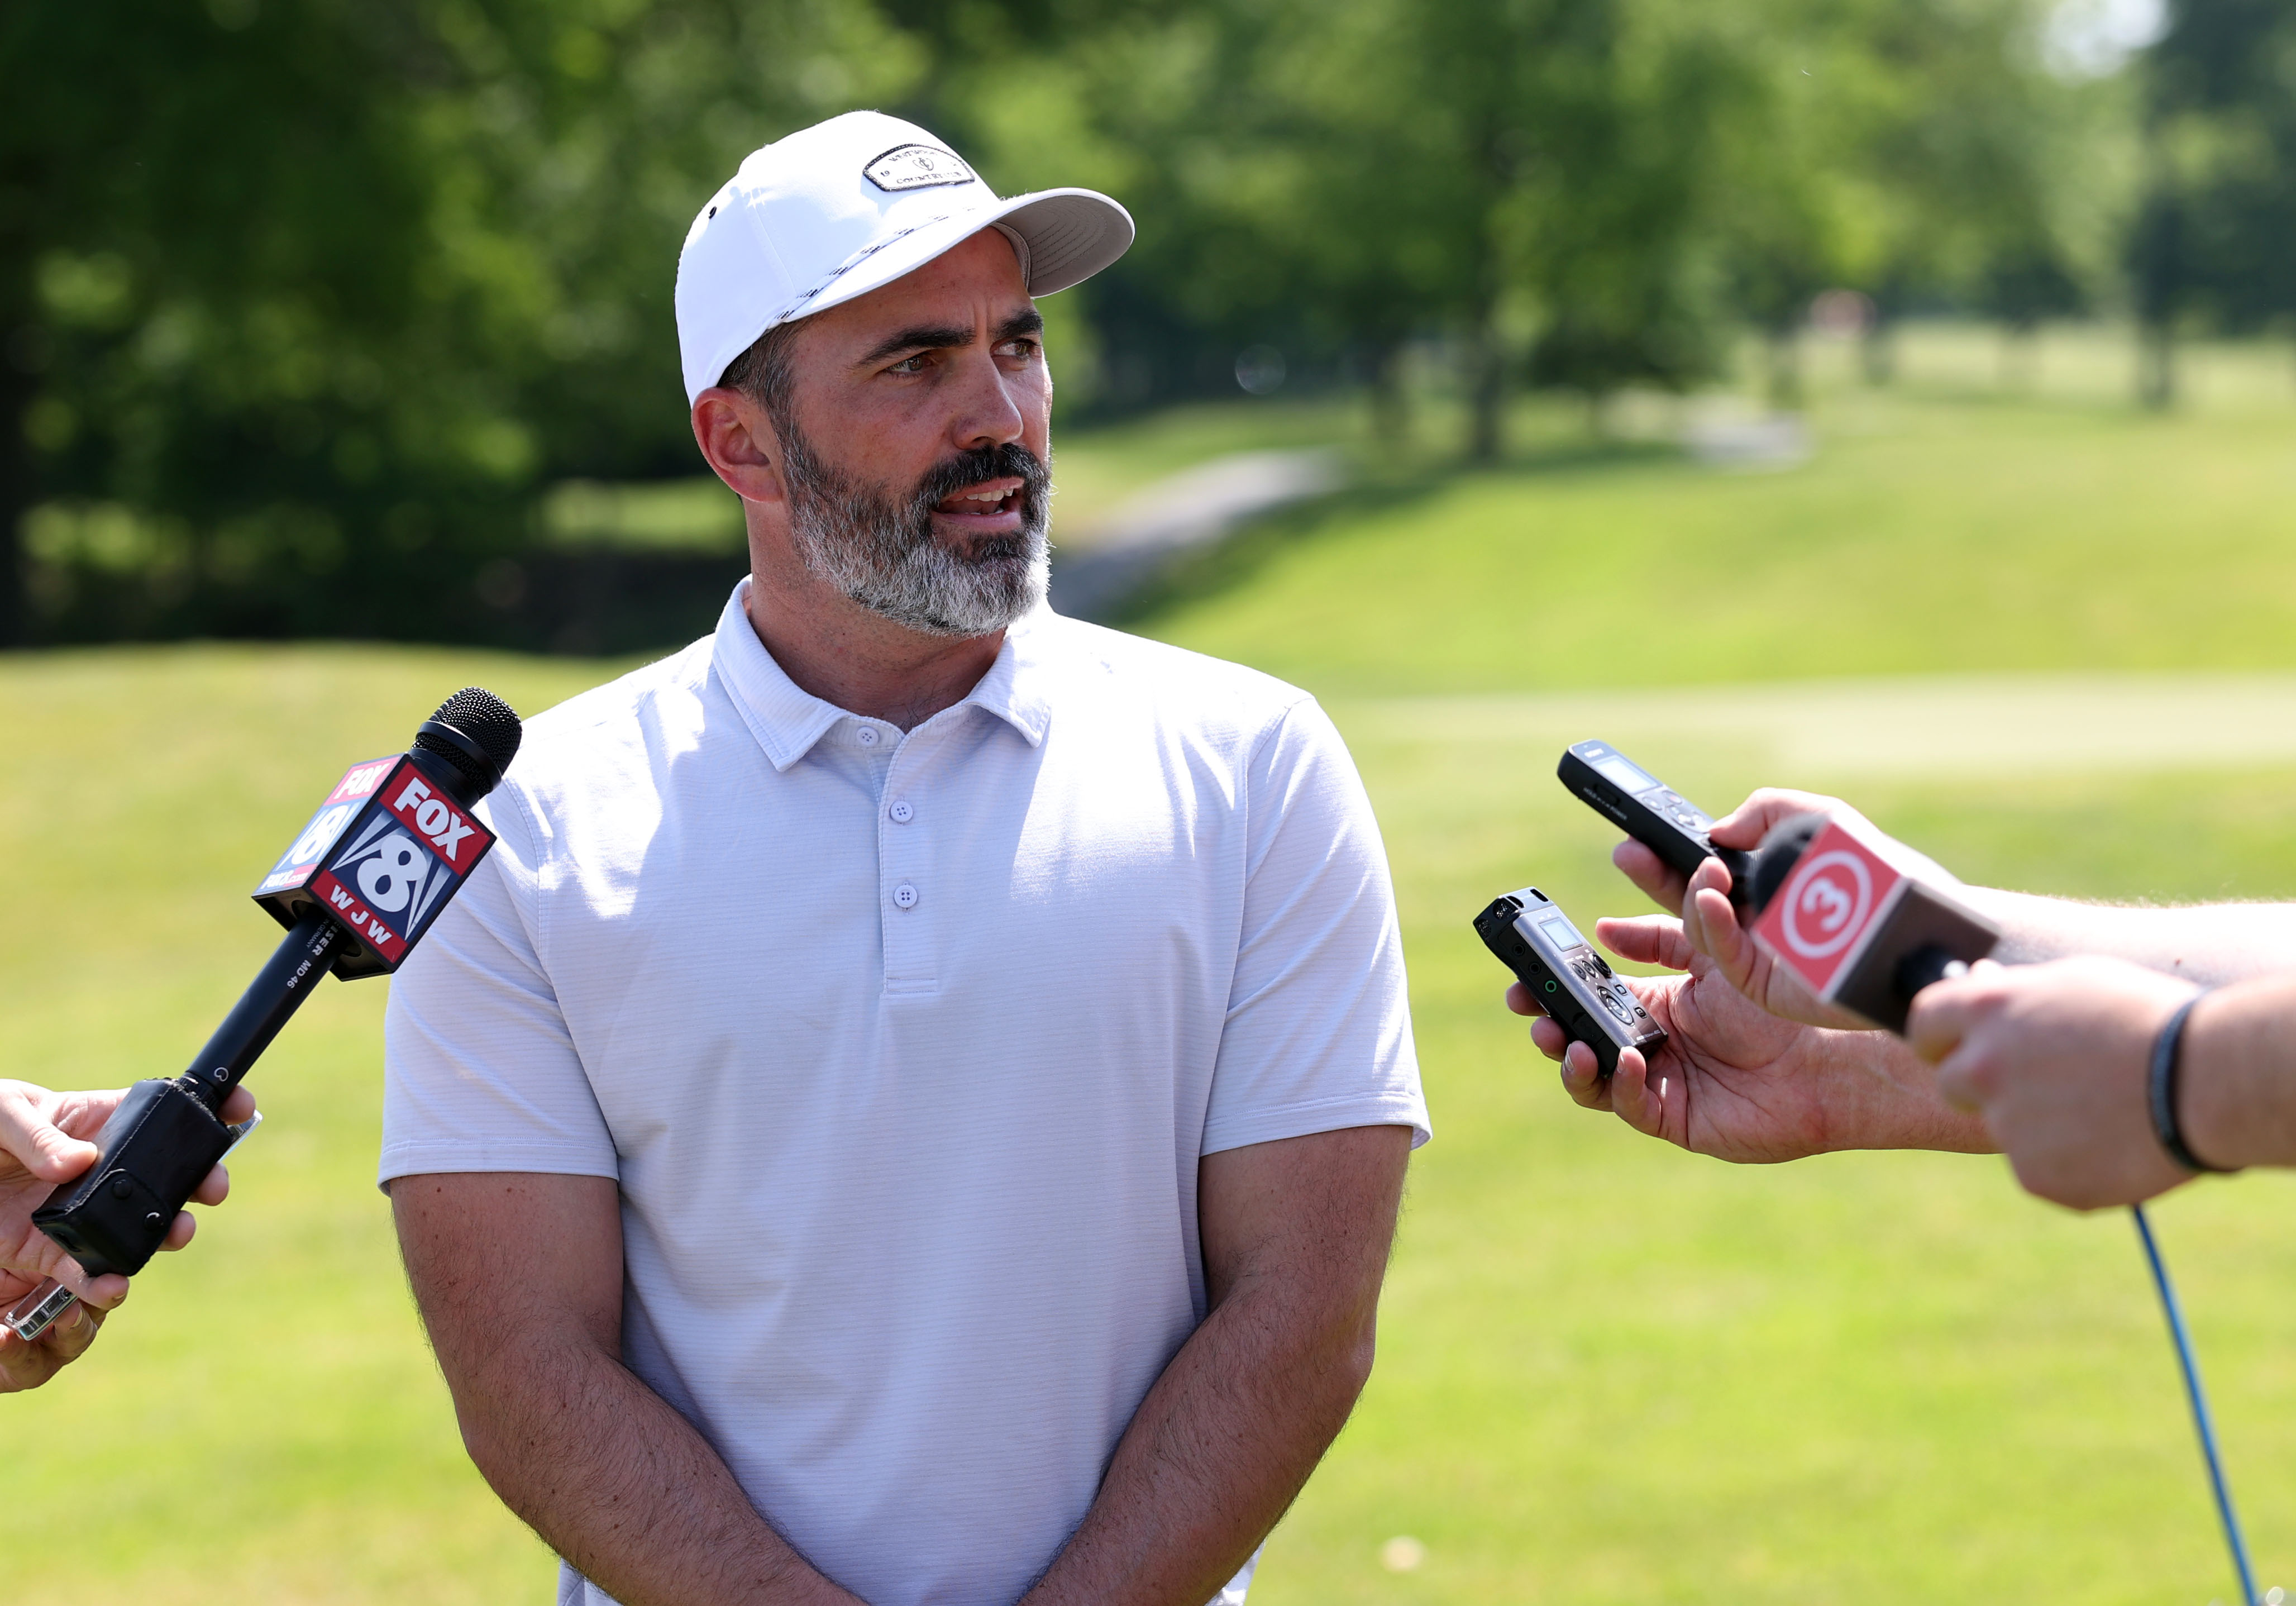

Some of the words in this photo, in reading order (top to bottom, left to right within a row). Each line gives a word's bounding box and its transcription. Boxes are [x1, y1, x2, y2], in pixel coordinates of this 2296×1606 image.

[889, 150, 937, 161] WESTW
[896, 172, 943, 184] COUNTRY
[333, 763, 390, 799] FOX
[393, 777, 475, 862] FOX
[291, 805, 349, 865] 8
[357, 835, 428, 912] 8
[1802, 877, 1851, 932] 3
[306, 924, 326, 949] GERMANY
[287, 976, 298, 989] 46
[296, 959, 312, 976] MD
